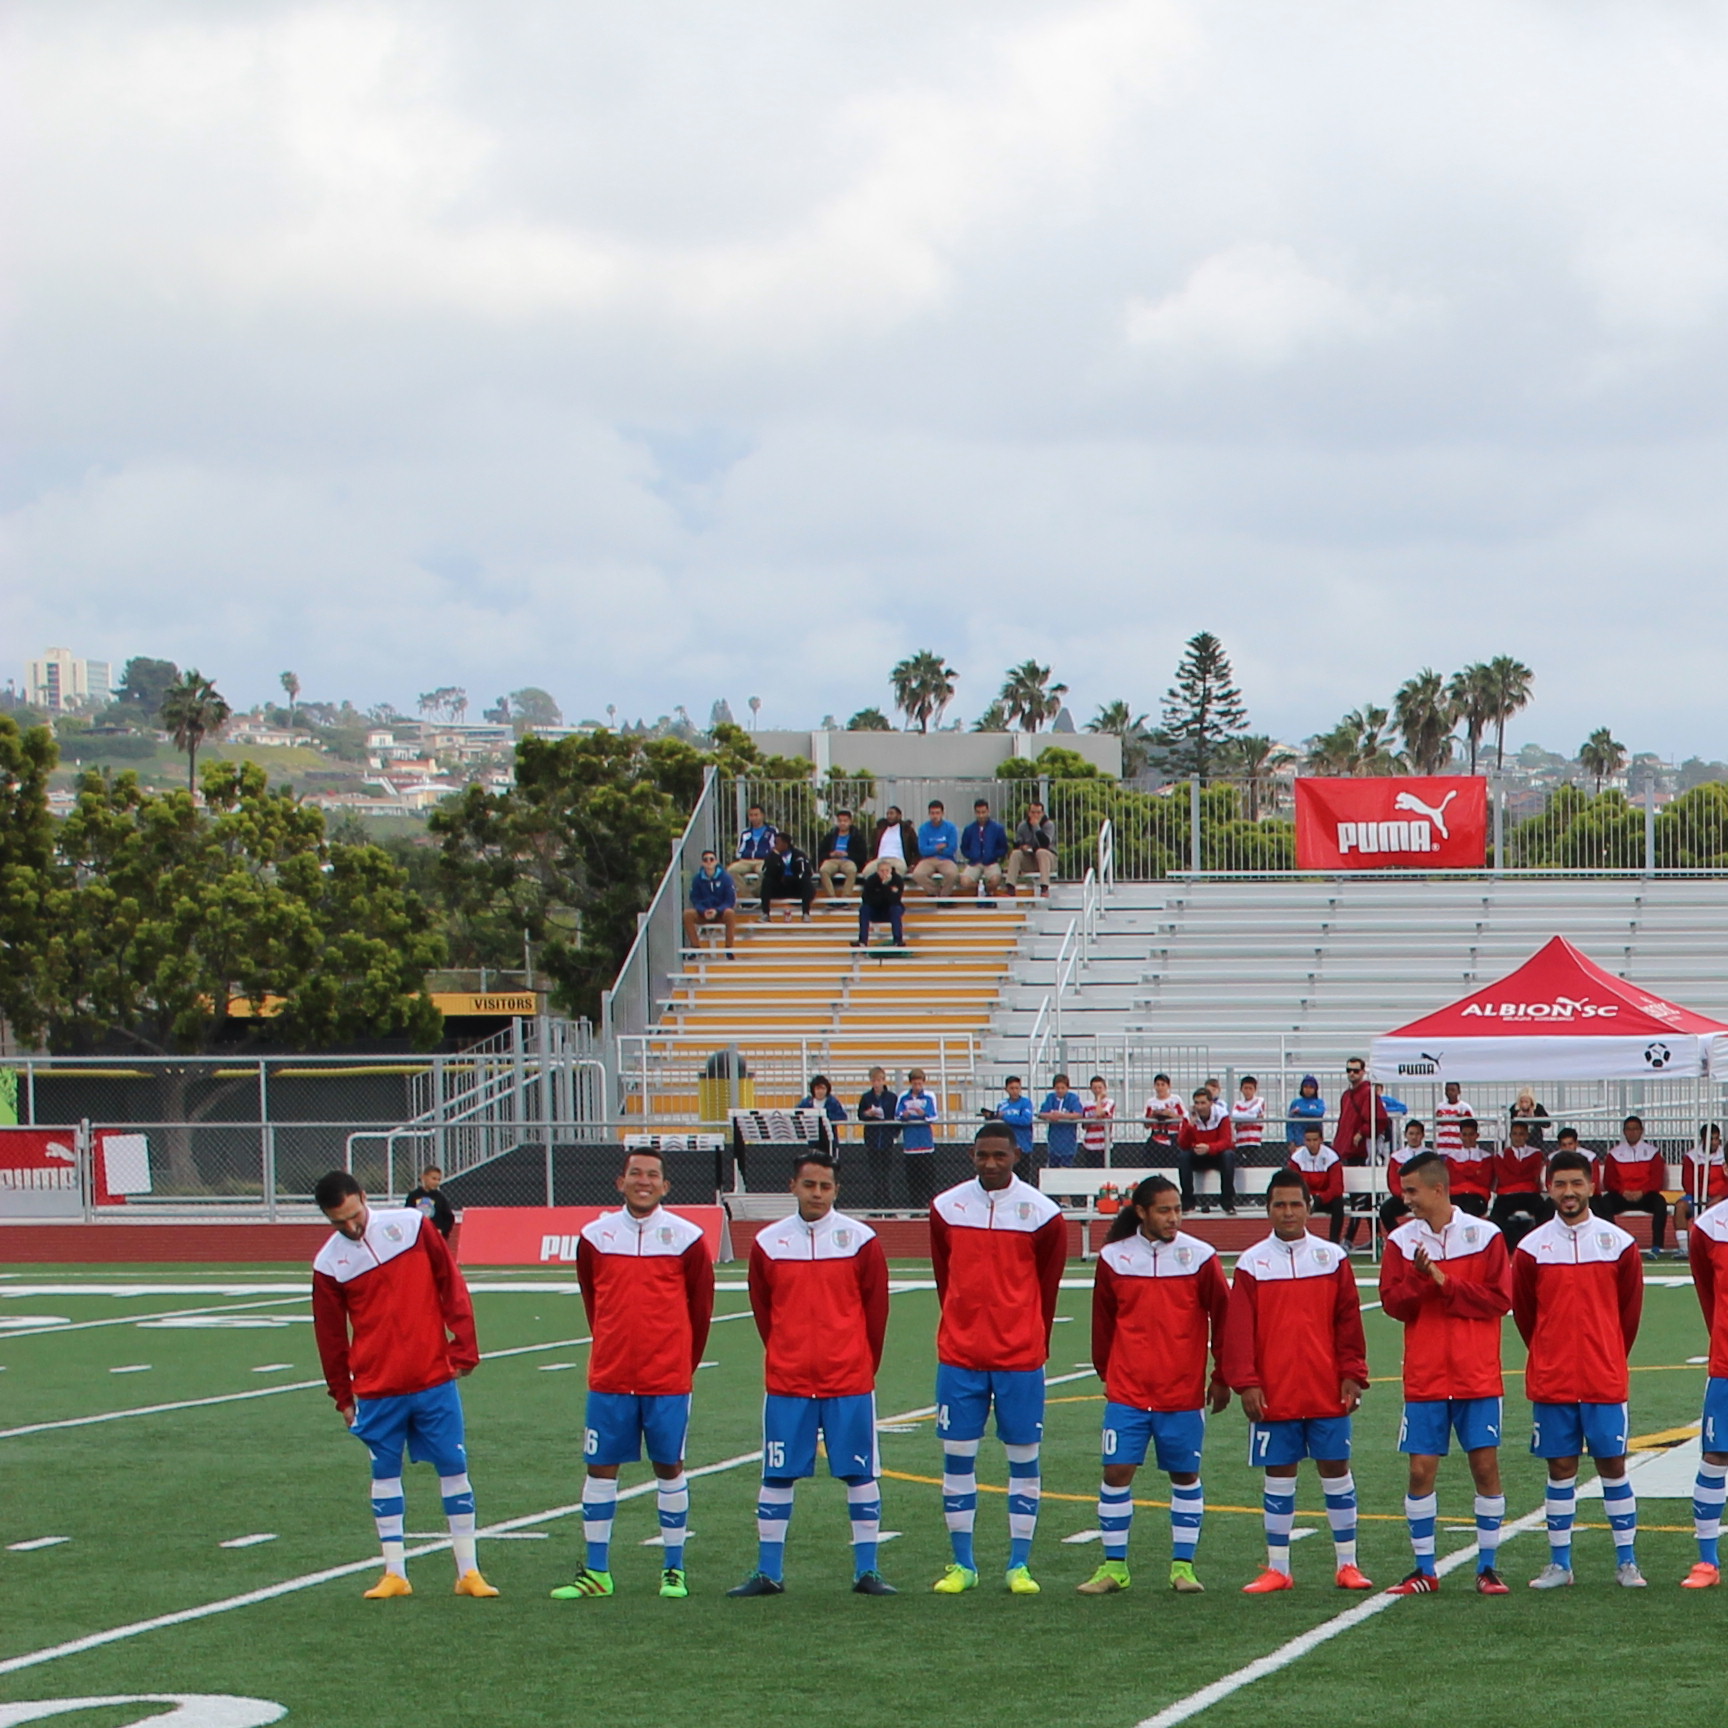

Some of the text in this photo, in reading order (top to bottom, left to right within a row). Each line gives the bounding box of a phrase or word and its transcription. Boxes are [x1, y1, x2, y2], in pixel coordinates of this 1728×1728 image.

[1337, 821, 1431, 854] PUMA
[475, 998, 532, 1010] VISITORS
[1461, 1003, 1618, 1017] ALBION SC
[1398, 1063, 1434, 1076] PUMA
[540, 1235, 580, 1261] PU
[1706, 1416, 1715, 1443] 4
[767, 1440, 785, 1468] 15
[1257, 1431, 1270, 1457] 7
